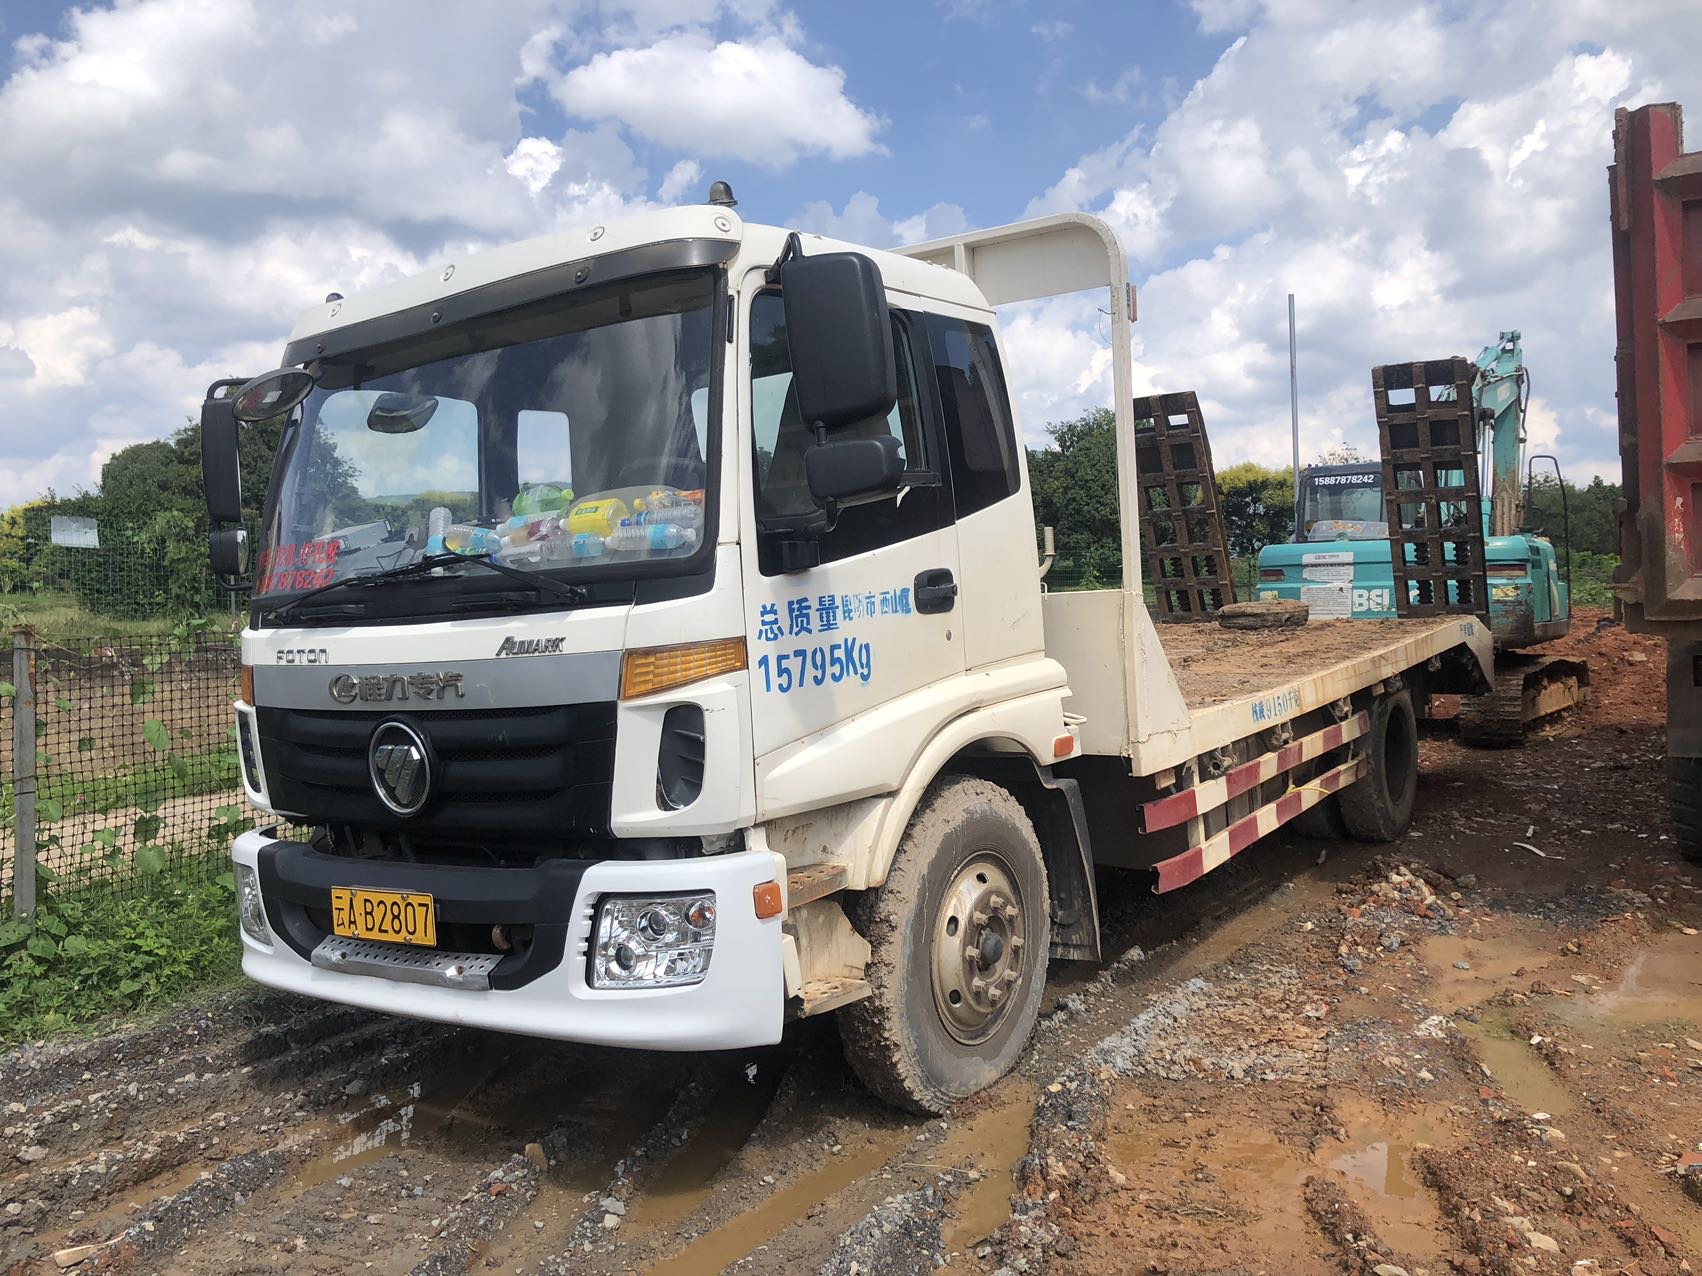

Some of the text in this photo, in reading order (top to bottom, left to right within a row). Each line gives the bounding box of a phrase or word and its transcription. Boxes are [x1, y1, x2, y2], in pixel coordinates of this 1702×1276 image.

[1314, 475, 1374, 486] 15887878242
[757, 594, 840, 642] 总质量
[276, 648, 329, 664] FOTON
[757, 637, 871, 694] 15795Kg
